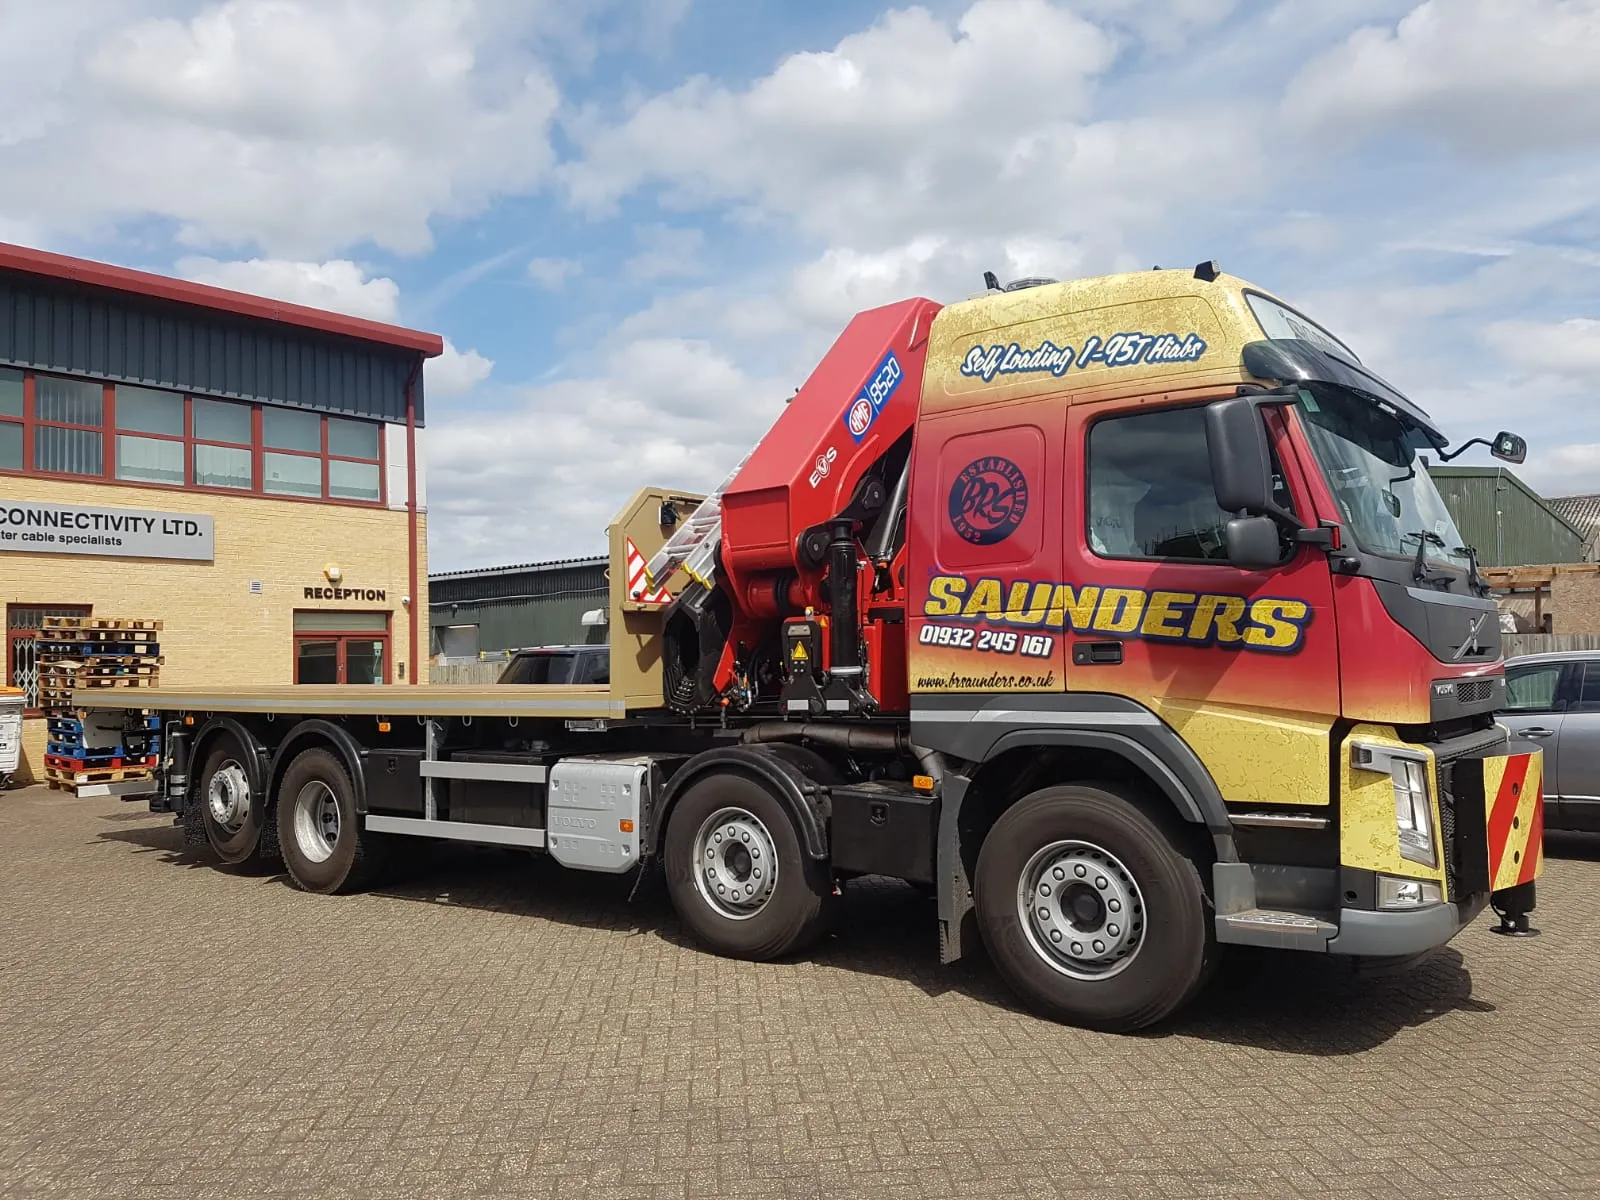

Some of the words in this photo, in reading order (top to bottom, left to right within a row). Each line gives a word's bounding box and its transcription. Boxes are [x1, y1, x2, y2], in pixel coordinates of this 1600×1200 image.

[962, 346, 1001, 379] Self
[1000, 344, 1072, 374] Loading
[1078, 334, 1152, 365] 1-95T
[1146, 335, 1202, 361] Hiabs
[870, 356, 900, 405] 8520
[851, 402, 870, 431] HMF
[960, 459, 1025, 523] ESTABLISHED
[21, 531, 55, 543] cable
[58, 534, 122, 546] specialists
[162, 519, 203, 537] LTD.
[953, 516, 980, 541] 1952
[303, 587, 386, 602] RECEPTION
[923, 575, 1309, 649] SAUNDERS
[919, 624, 976, 648] 01932
[977, 629, 1018, 652] 245
[1020, 634, 1053, 656] 161
[917, 669, 1056, 689] www.brsaunders.co.uk
